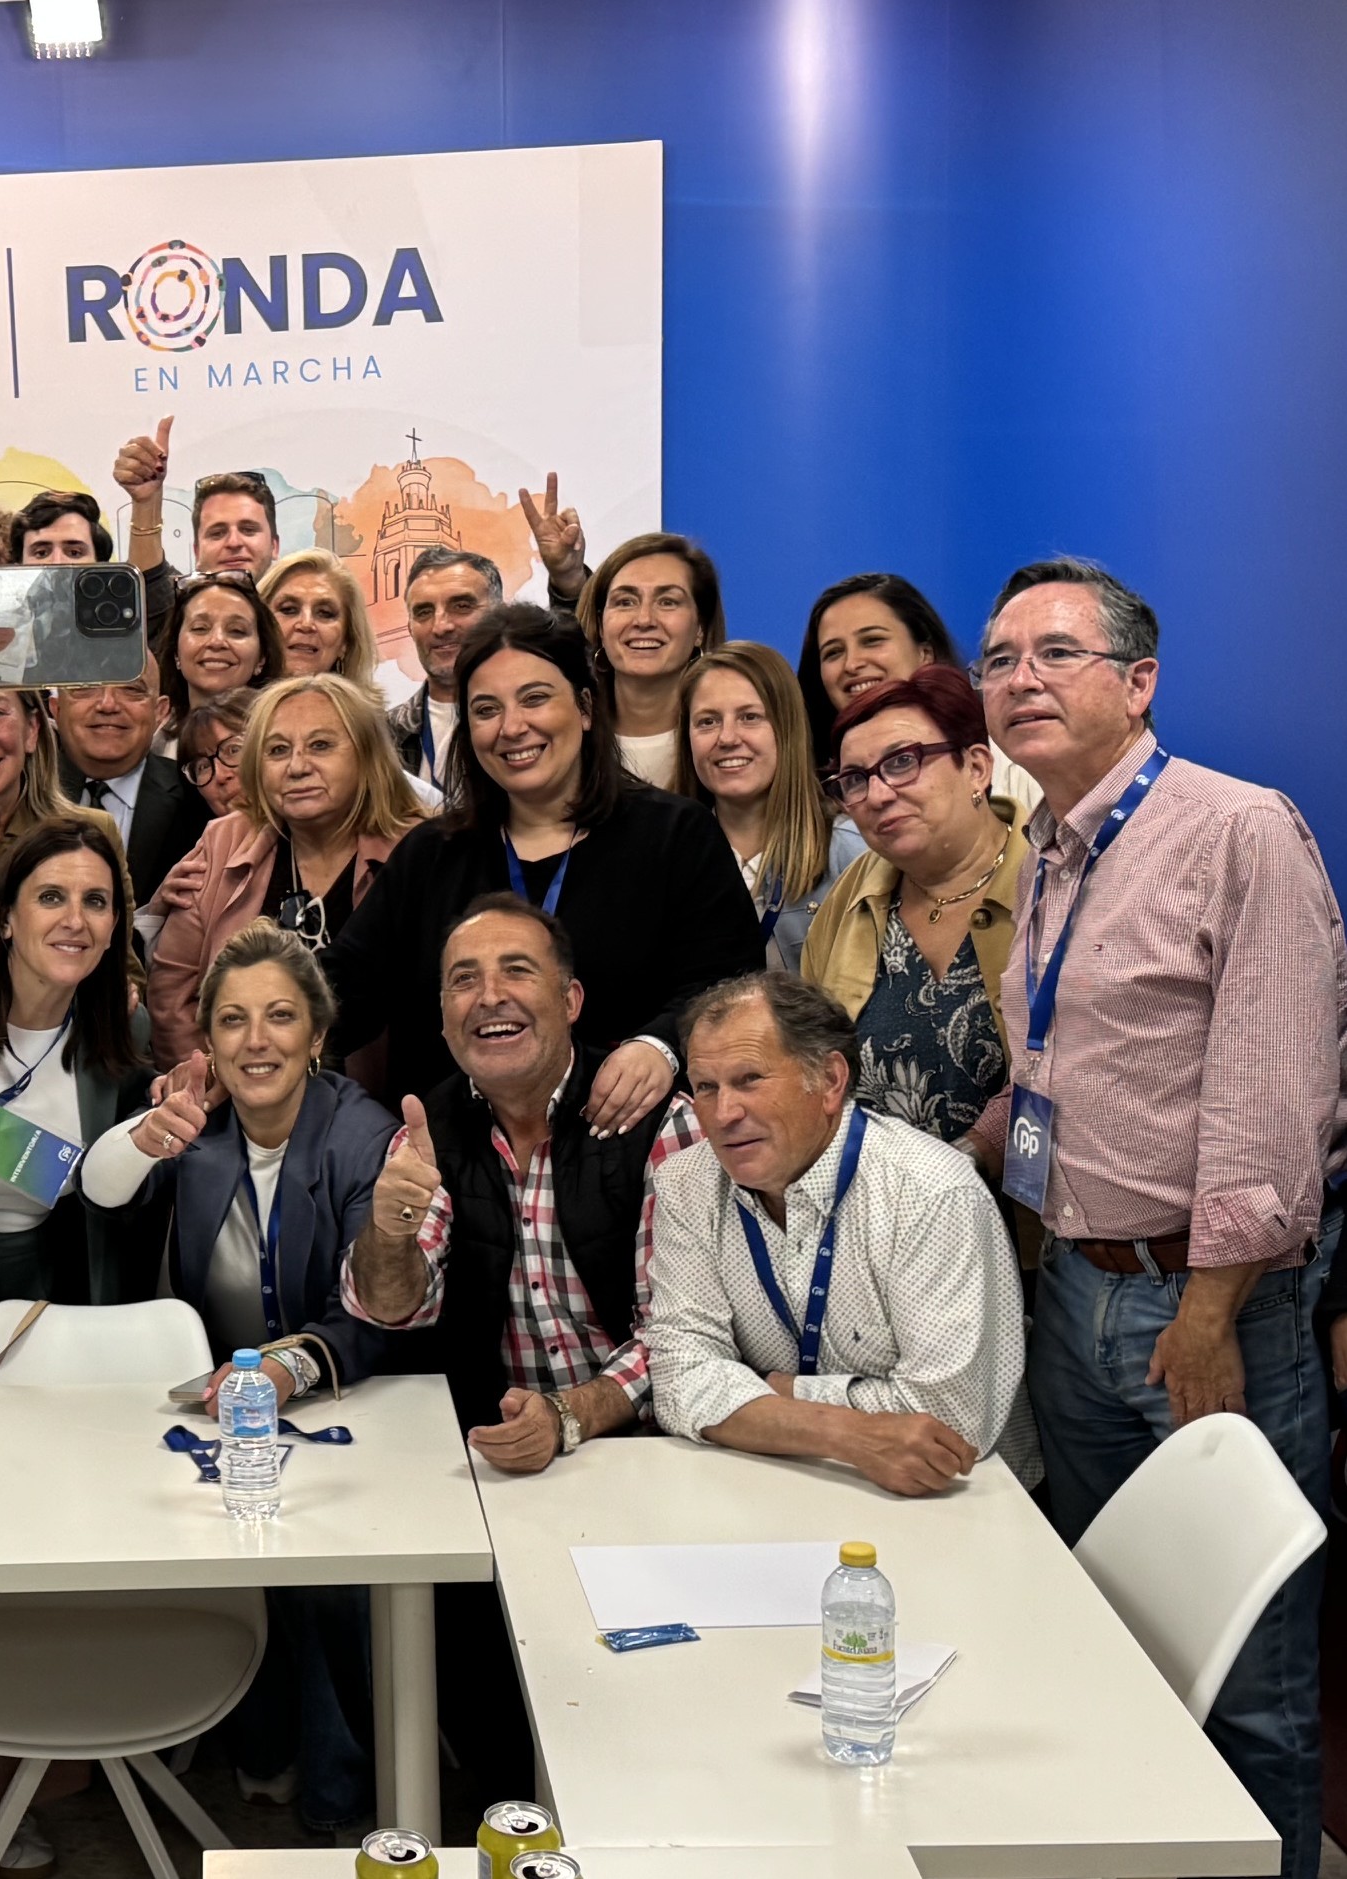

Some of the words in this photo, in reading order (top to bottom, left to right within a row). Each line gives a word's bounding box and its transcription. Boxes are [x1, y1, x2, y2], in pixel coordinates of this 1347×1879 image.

[65, 239, 444, 352] RONDA
[134, 366, 179, 392] EN
[208, 354, 383, 389] MARCHA
